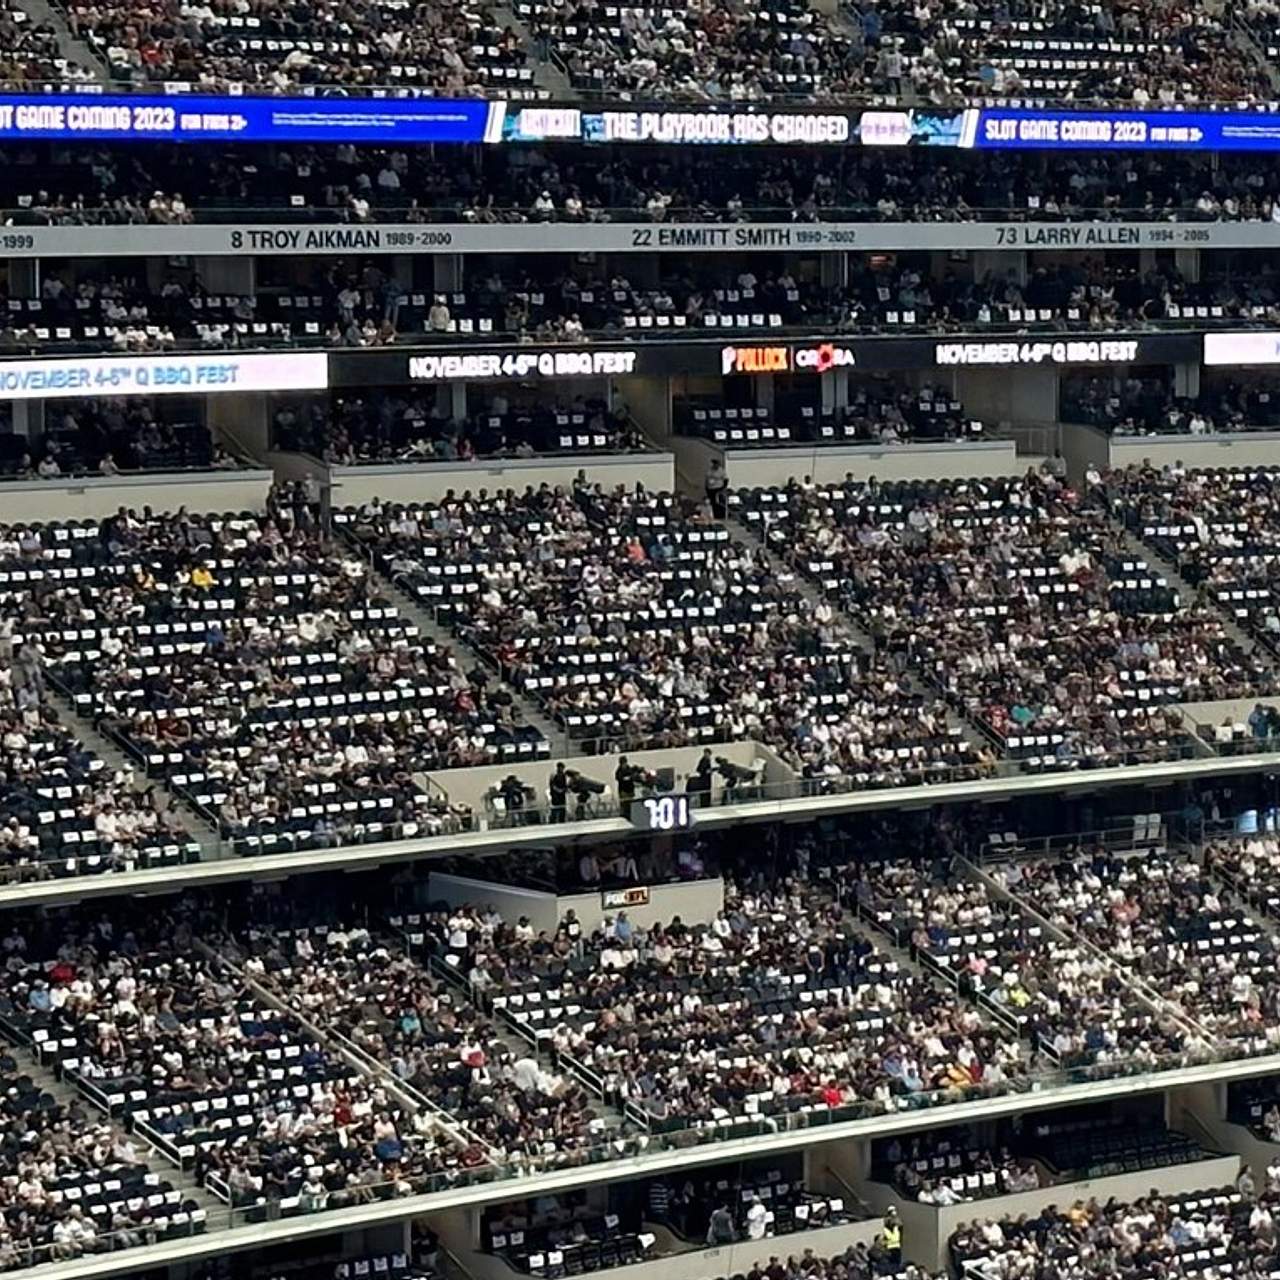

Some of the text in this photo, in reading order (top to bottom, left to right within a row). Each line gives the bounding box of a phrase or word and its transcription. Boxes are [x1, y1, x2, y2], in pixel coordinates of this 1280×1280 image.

[16, 106, 64, 129] GAME
[68, 107, 130, 129] COMING
[133, 107, 175, 130] 2023
[604, 112, 637, 140] THE
[642, 113, 729, 141] PLAYBOOK
[734, 113, 768, 141] HAS
[771, 115, 848, 142] CHANGED
[985, 119, 1017, 140] SLOT
[1019, 120, 1059, 140] GAME
[1114, 121, 1146, 141] 2023
[231, 231, 243, 247] 8
[247, 231, 300, 248] TROY
[305, 230, 380, 248] AIKMAN
[633, 229, 652, 246] 22
[658, 229, 730, 246] EMMITT
[736, 229, 791, 246] SMITH
[996, 228, 1017, 244] 73
[1025, 228, 1081, 245] LARRY
[1086, 228, 1140, 244] ALLEN
[936, 344, 1019, 364] NOVEMBER
[1052, 343, 1066, 362] Q
[1067, 342, 1100, 361] BBQ
[1101, 341, 1137, 361] FEST
[135, 368, 148, 386] Q
[153, 366, 192, 385] BBQ
[196, 364, 239, 384] FEST
[409, 356, 501, 378] NOVEMBER
[538, 354, 554, 375] Q
[555, 353, 592, 374] BBQ
[594, 352, 636, 373] FEST
[644, 797, 688, 829] 7:01
